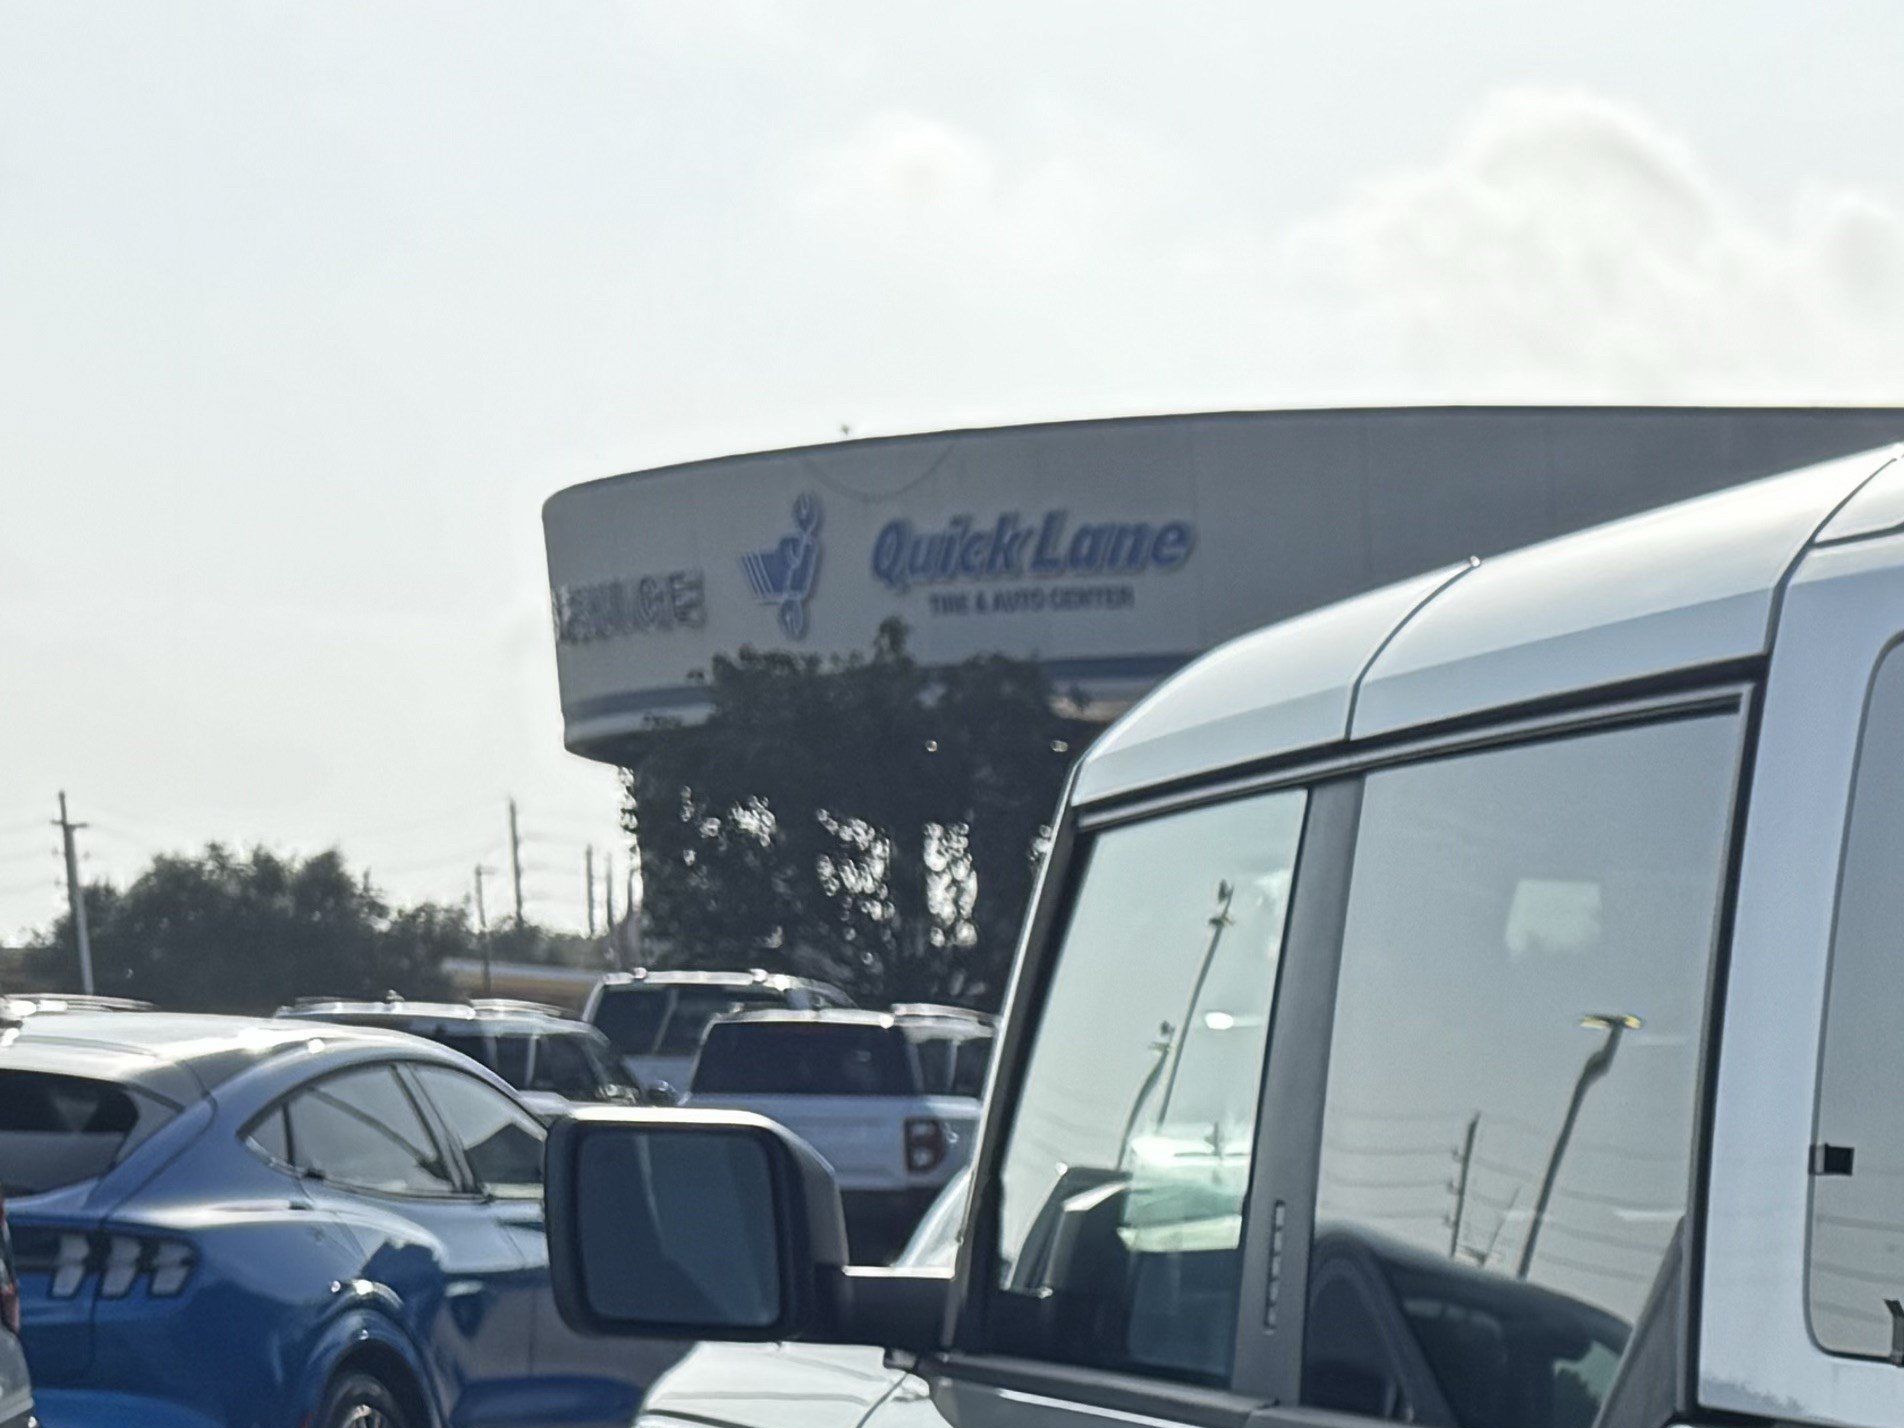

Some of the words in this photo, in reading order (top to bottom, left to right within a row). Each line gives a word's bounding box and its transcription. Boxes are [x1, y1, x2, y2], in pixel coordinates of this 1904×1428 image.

[871, 511, 1034, 594] Quick
[1031, 508, 1197, 577] Lane
[992, 587, 1045, 612] AUTO
[1050, 585, 1134, 611] CENTER
